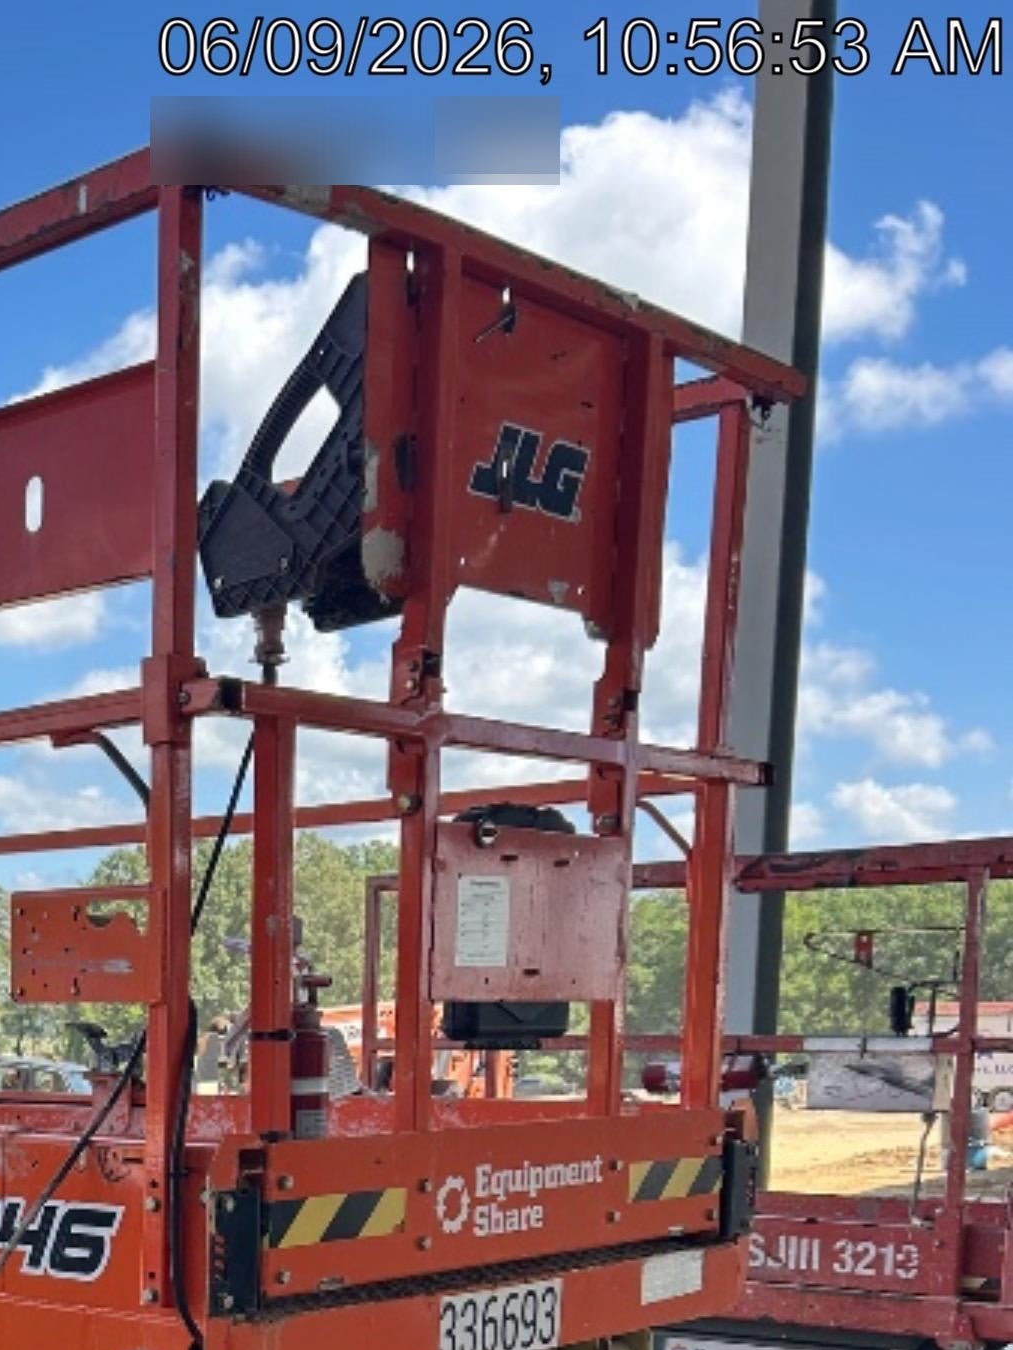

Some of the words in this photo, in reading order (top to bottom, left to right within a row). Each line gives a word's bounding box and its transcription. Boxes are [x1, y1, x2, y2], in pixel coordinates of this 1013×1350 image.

[467, 420, 591, 524] JLG
[475, 1154, 604, 1200] Equipment
[474, 1203, 545, 1237] Share
